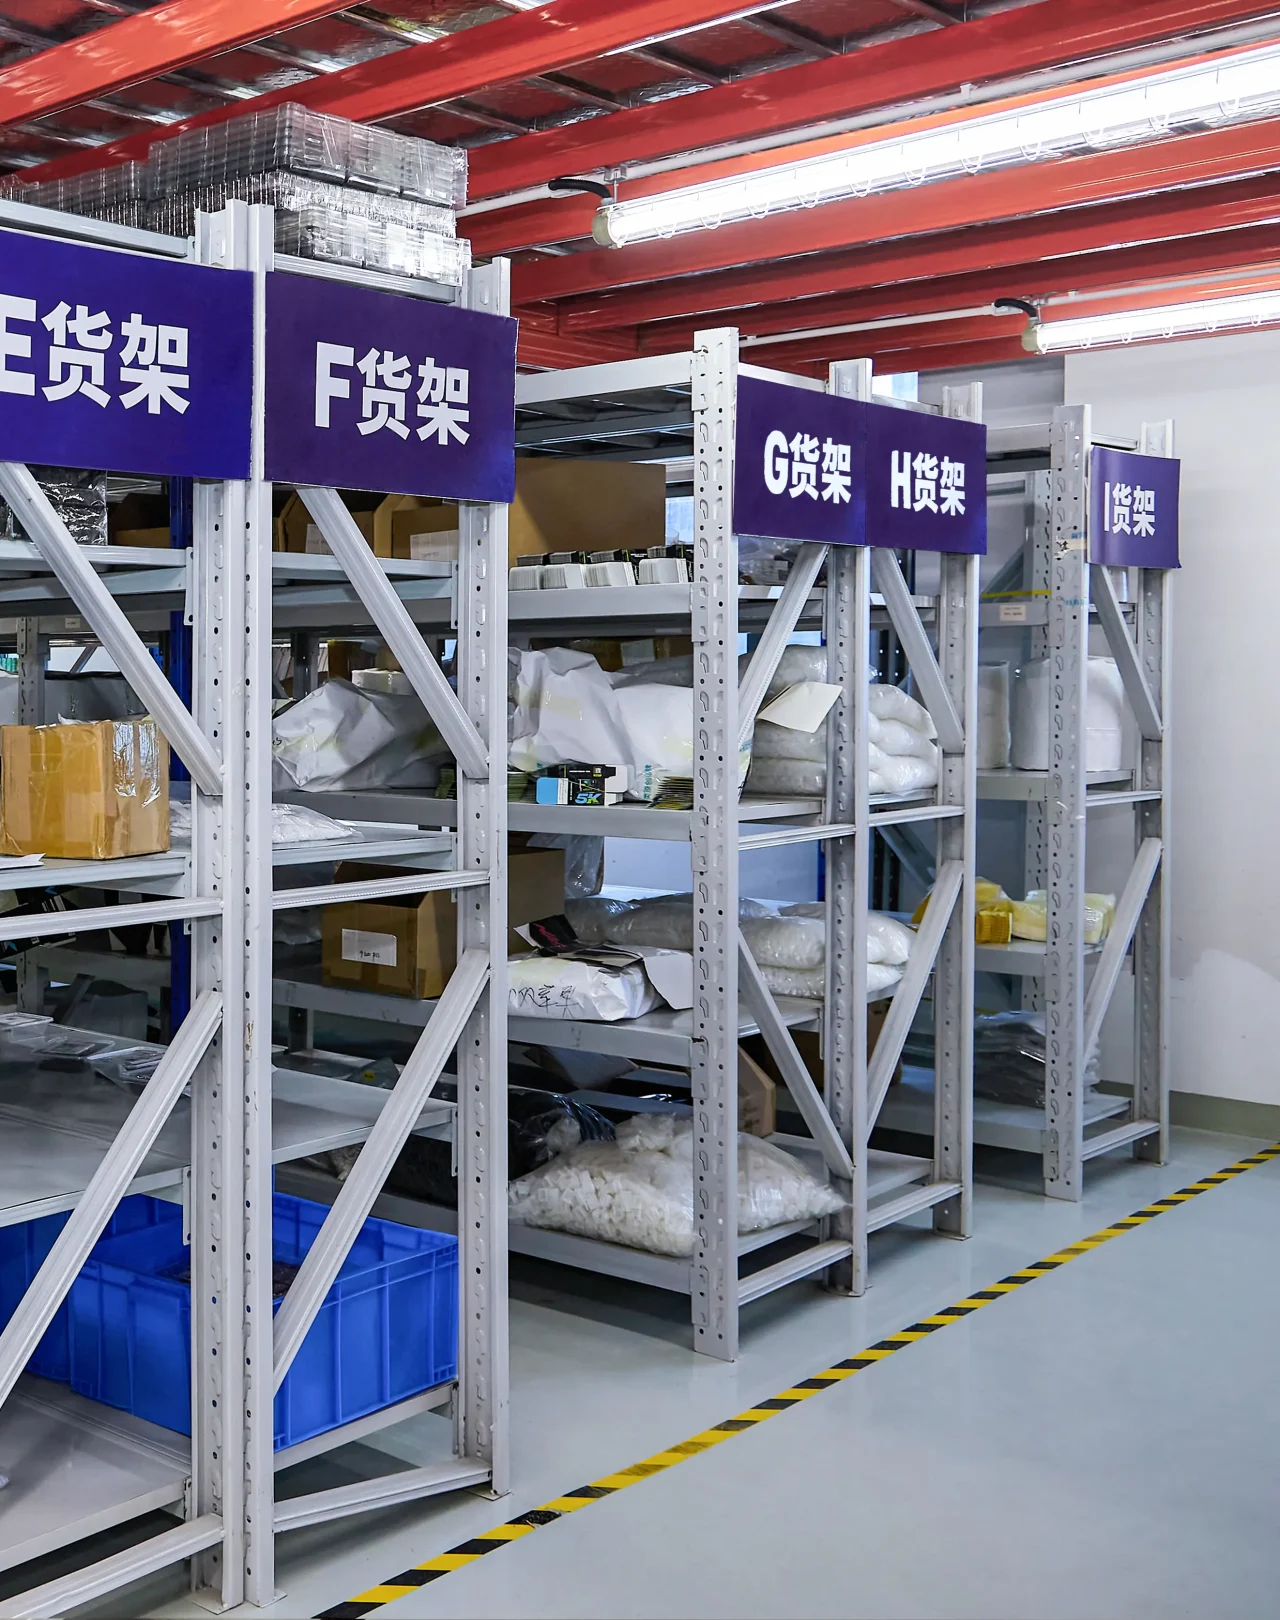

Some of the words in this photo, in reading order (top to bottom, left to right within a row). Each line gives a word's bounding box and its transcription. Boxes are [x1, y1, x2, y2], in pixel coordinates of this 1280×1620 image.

[314, 341, 471, 446] F货架
[763, 429, 852, 504] G货架
[890, 449, 966, 516] H货架
[1103, 481, 1156, 538] I货架
[575, 793, 602, 804] 5K
